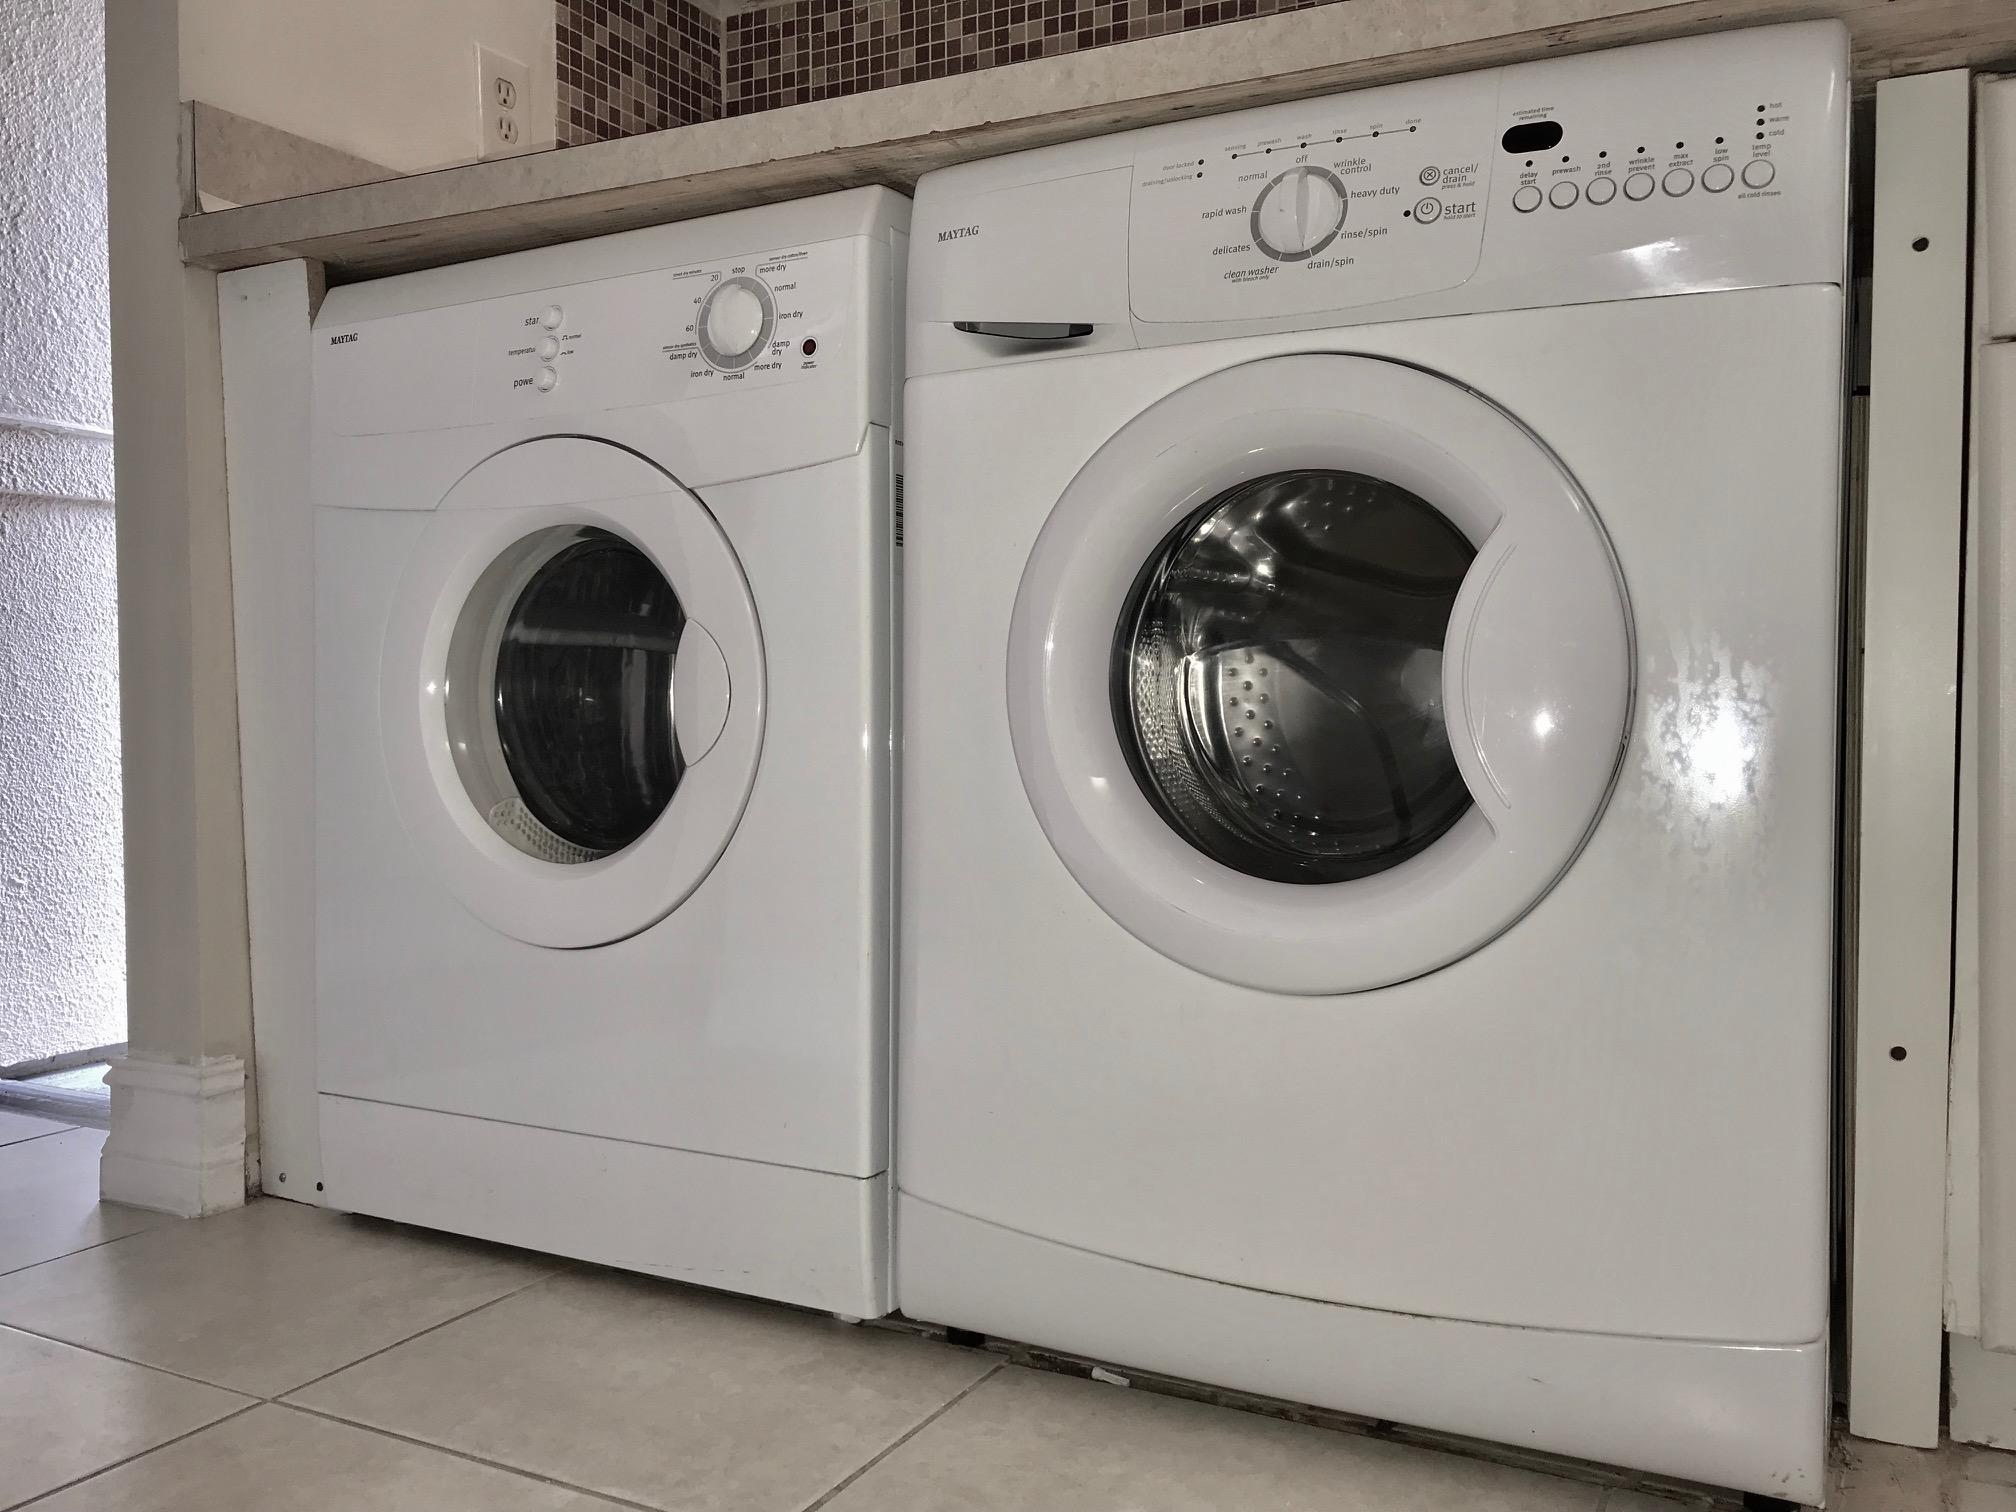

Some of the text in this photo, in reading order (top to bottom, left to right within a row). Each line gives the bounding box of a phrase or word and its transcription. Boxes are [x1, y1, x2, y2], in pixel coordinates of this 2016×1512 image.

[1296, 154, 1308, 164] off
[1334, 157, 1366, 168] wrinkle
[1628, 156, 1655, 165] wrinkle
[1669, 159, 1693, 167] extract
[1713, 155, 1729, 163] spin
[1341, 164, 1372, 175] control
[1443, 163, 1478, 175] cancel/
[1552, 165, 1581, 176] prewash
[1595, 168, 1612, 176] rinse
[1628, 164, 1655, 173] prevent
[1238, 170, 1268, 182] normal
[1443, 174, 1466, 183] drain
[1351, 186, 1400, 198] heavy duty
[1202, 205, 1247, 220] rapid wash
[1445, 202, 1476, 214] start
[938, 226, 979, 242] MAYTAG
[1341, 227, 1388, 239] rinse/spin
[1212, 244, 1251, 255] delicates
[1308, 257, 1354, 269] drain/spin
[1224, 266, 1279, 280] clean washer
[774, 282, 796, 292] normal
[525, 317, 539, 326] star
[330, 333, 358, 345] MAYTAG
[723, 372, 744, 381] normal
[514, 377, 533, 389] powe
